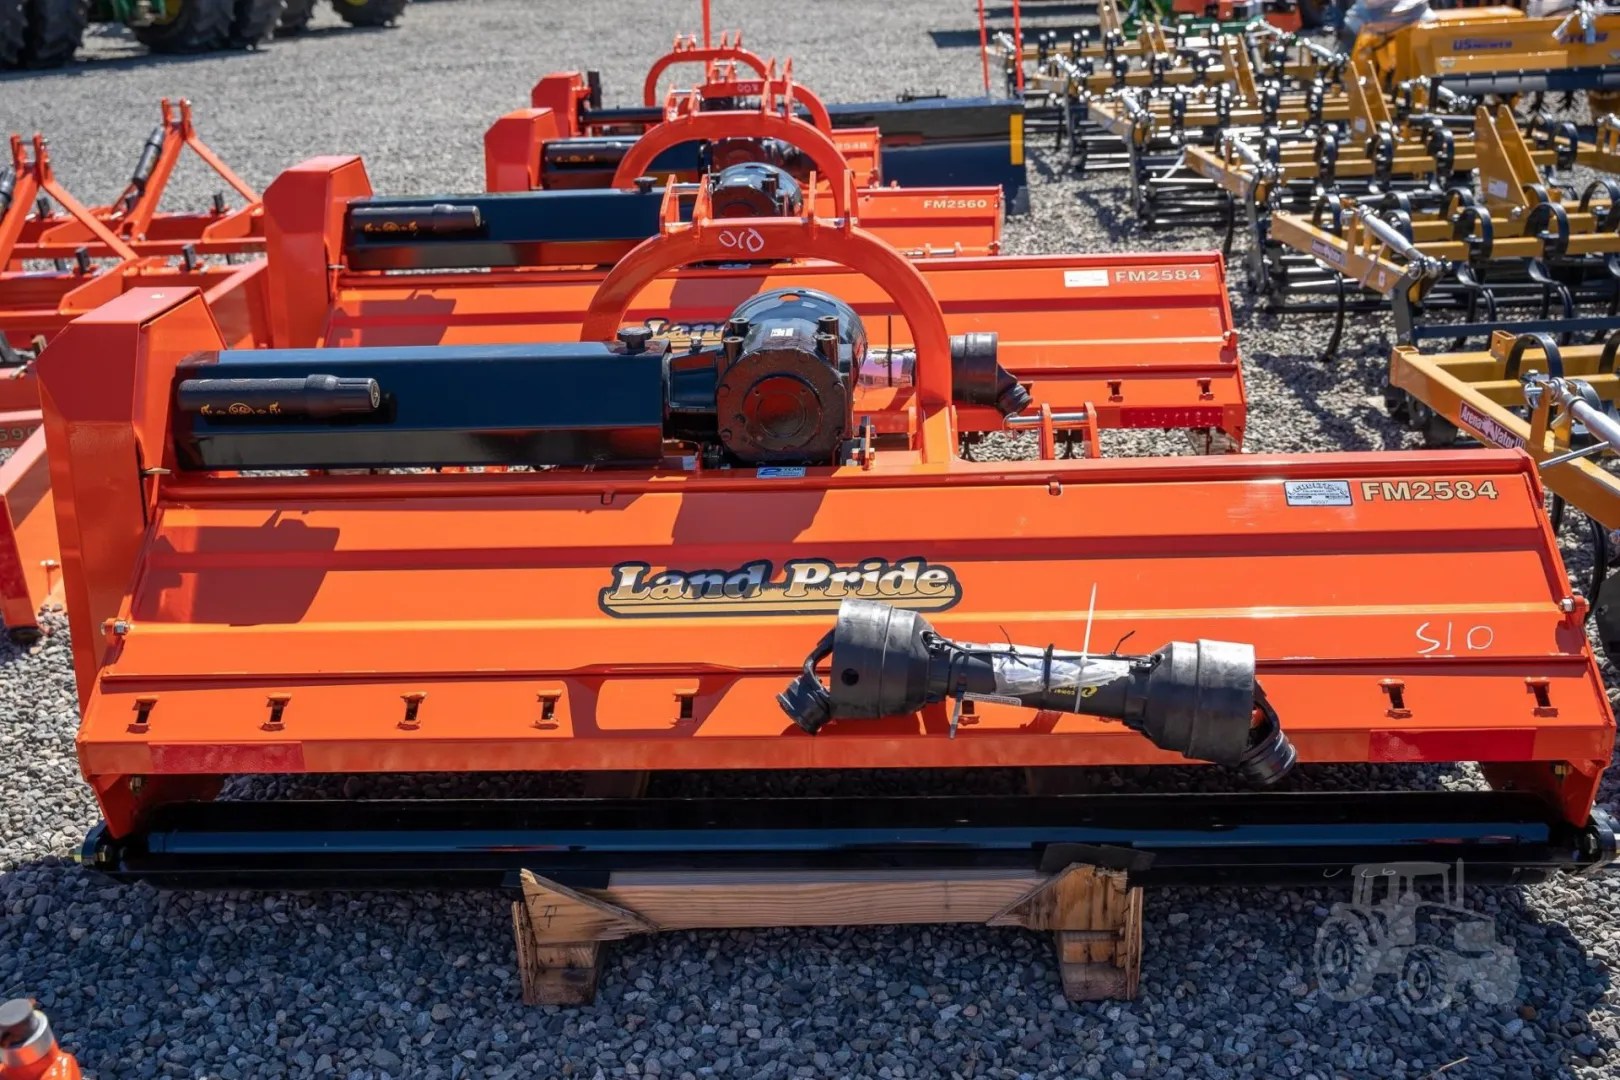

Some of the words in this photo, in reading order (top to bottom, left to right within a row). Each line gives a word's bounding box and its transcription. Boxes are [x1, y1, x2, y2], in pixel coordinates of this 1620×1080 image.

[923, 200, 987, 208] FM2560
[1115, 270, 1201, 282] FM2584
[1461, 405, 1482, 430] Arena
[1361, 481, 1499, 501] FM2584
[608, 564, 765, 600] Land
[784, 561, 950, 598] Pride
